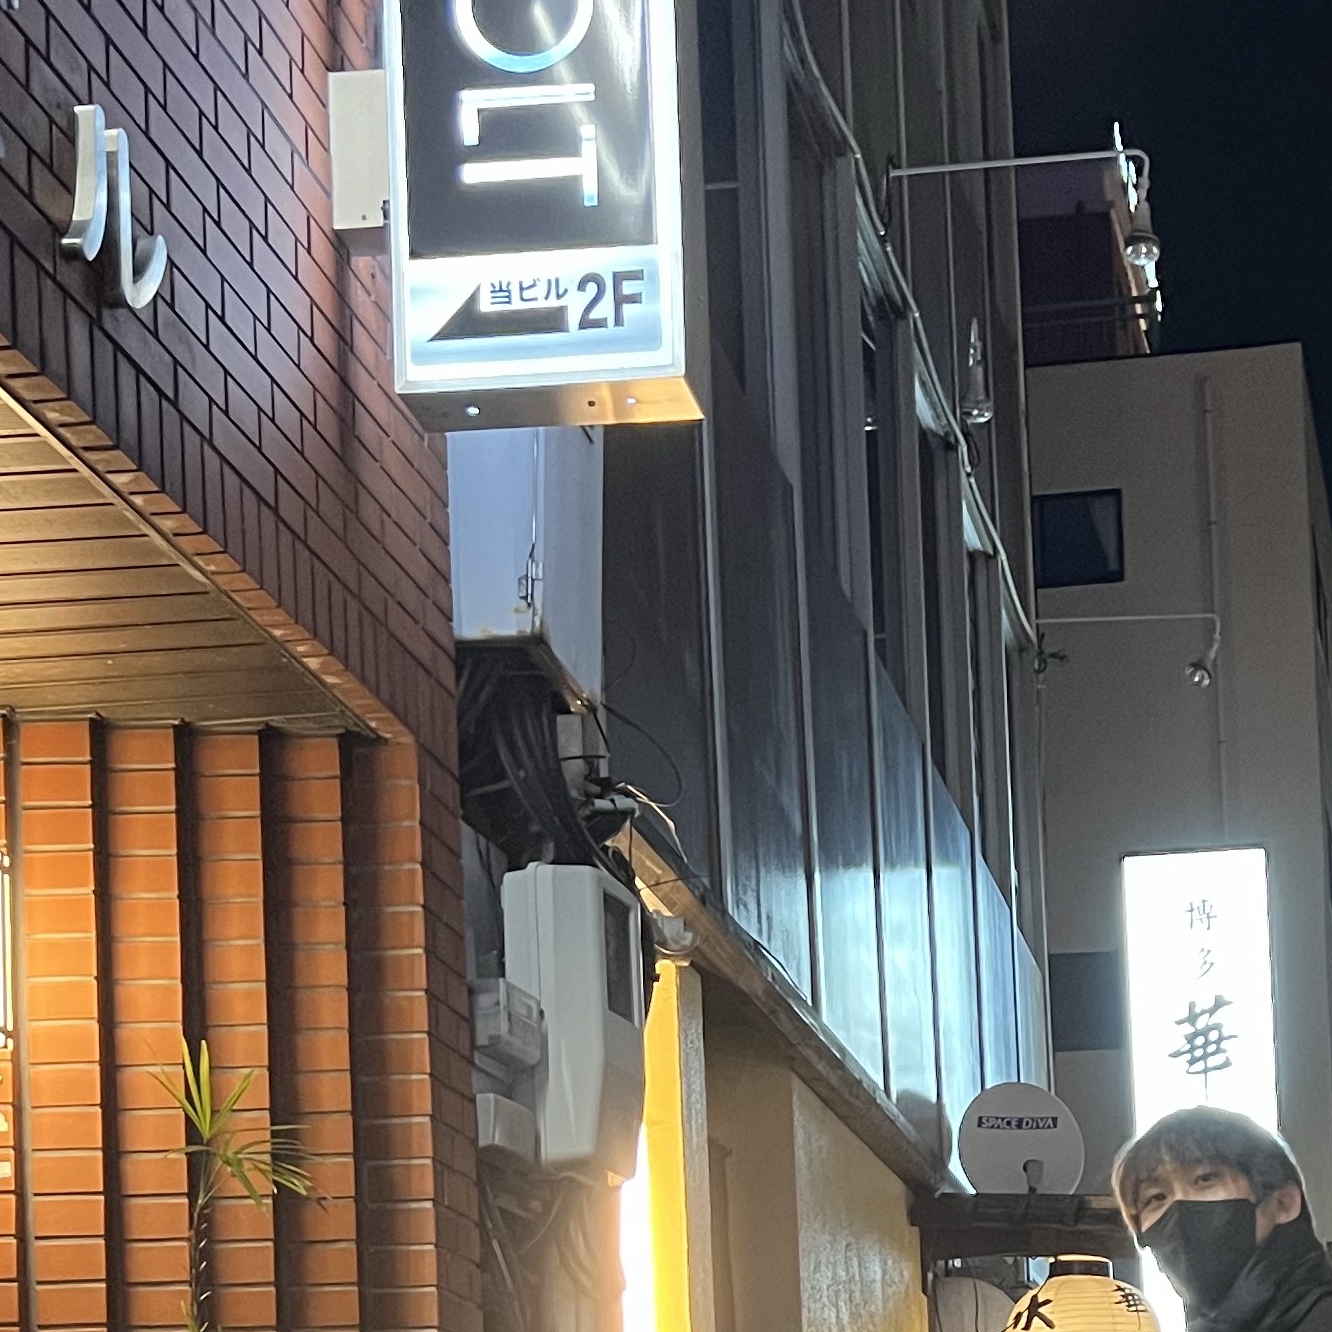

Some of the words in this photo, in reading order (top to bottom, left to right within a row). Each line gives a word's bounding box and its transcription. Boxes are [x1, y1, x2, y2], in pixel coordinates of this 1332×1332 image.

[489, 277, 569, 305] 当ビル
[577, 269, 645, 331] 2F
[980, 1116, 1019, 1130] SPACE
